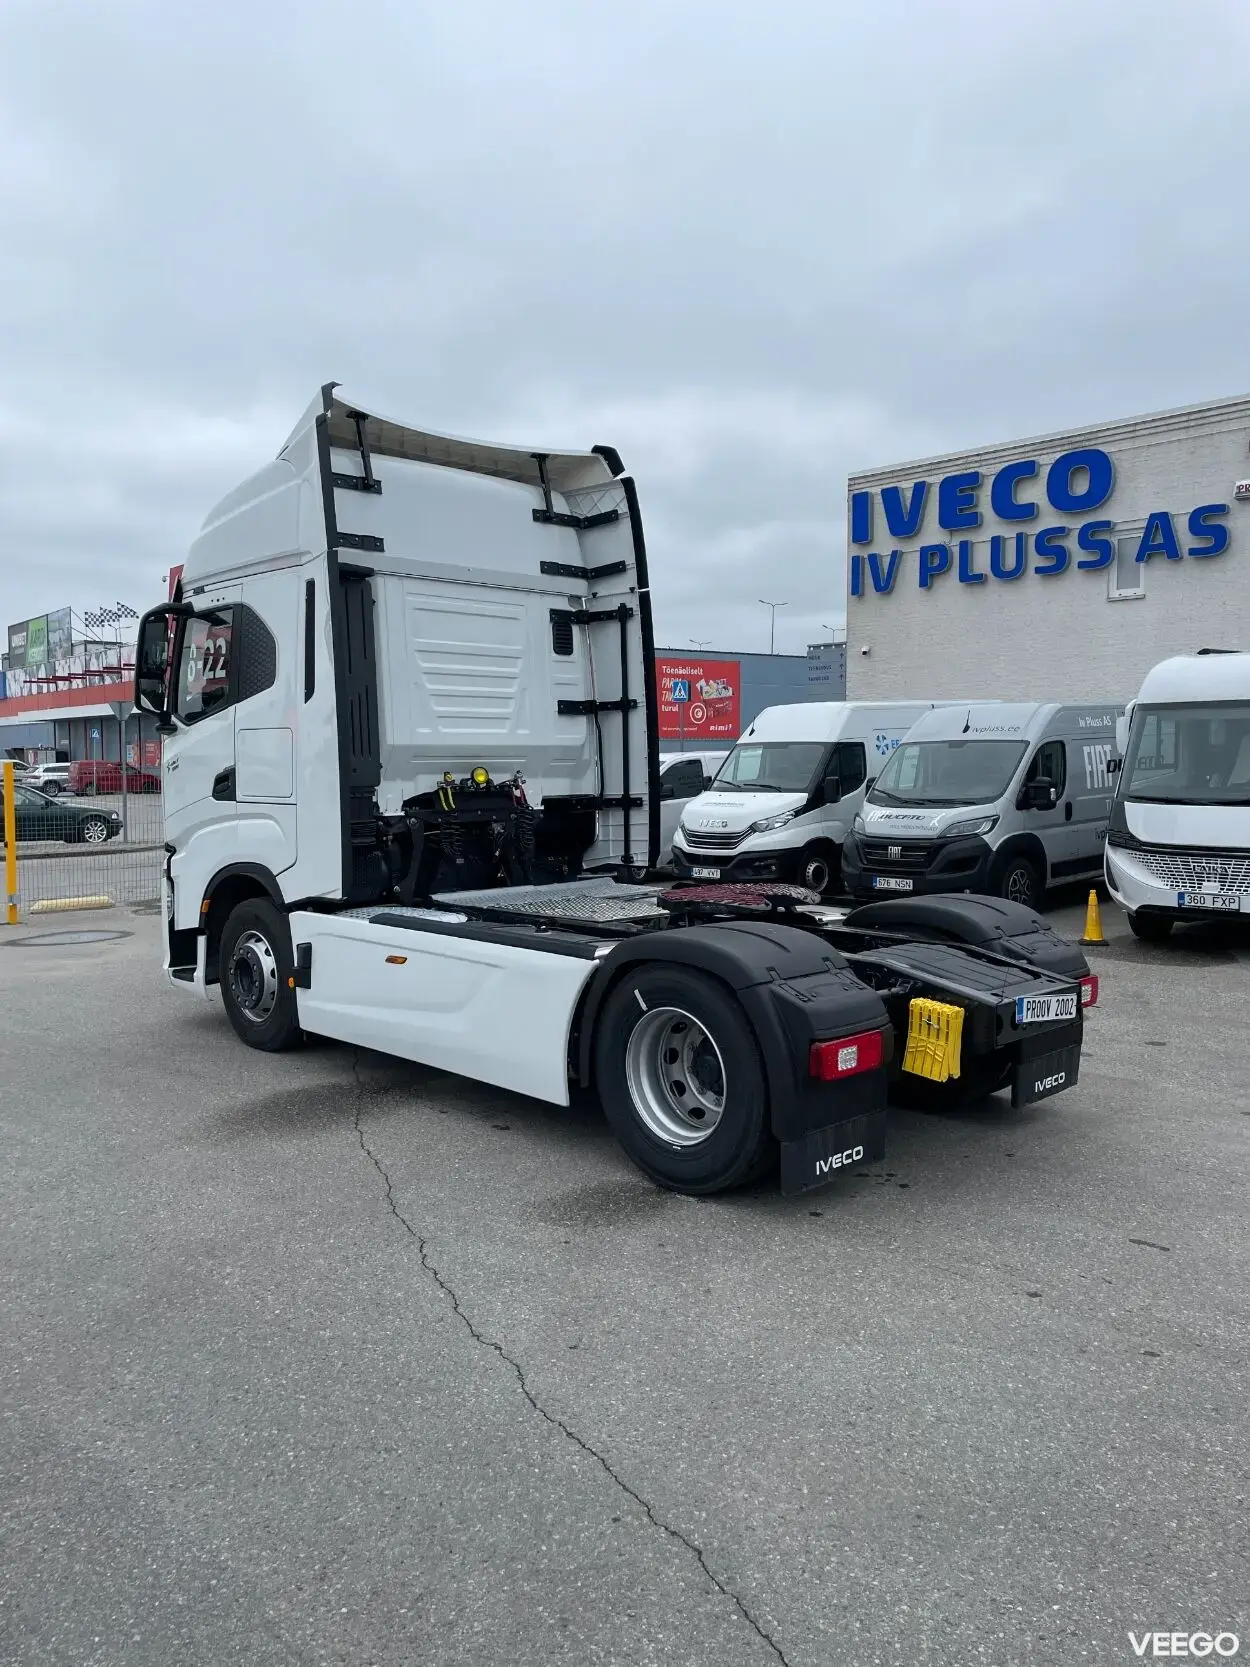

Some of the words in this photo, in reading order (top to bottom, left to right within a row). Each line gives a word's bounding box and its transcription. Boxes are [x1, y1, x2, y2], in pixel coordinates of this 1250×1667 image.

[851, 448, 1116, 544] IVECO
[850, 549, 902, 597] IV
[918, 519, 1116, 589] PLUSS
[1134, 503, 1231, 563] AS
[661, 666, 703, 675] Tõenäoliselt
[1086, 715, 1103, 727] Pluss
[1103, 715, 1112, 726] AS
[1083, 744, 1112, 789] FIAT
[699, 820, 728, 828] IVECO
[887, 846, 902, 859] FIAT
[878, 878, 891, 887] 676
[894, 879, 911, 888] NSN
[1186, 894, 1206, 905] 360
[1212, 896, 1236, 907] FXP
[1055, 997, 1074, 1017] 2002
[1034, 1071, 1066, 1093] IVECO
[816, 1145, 864, 1176] IVECO
